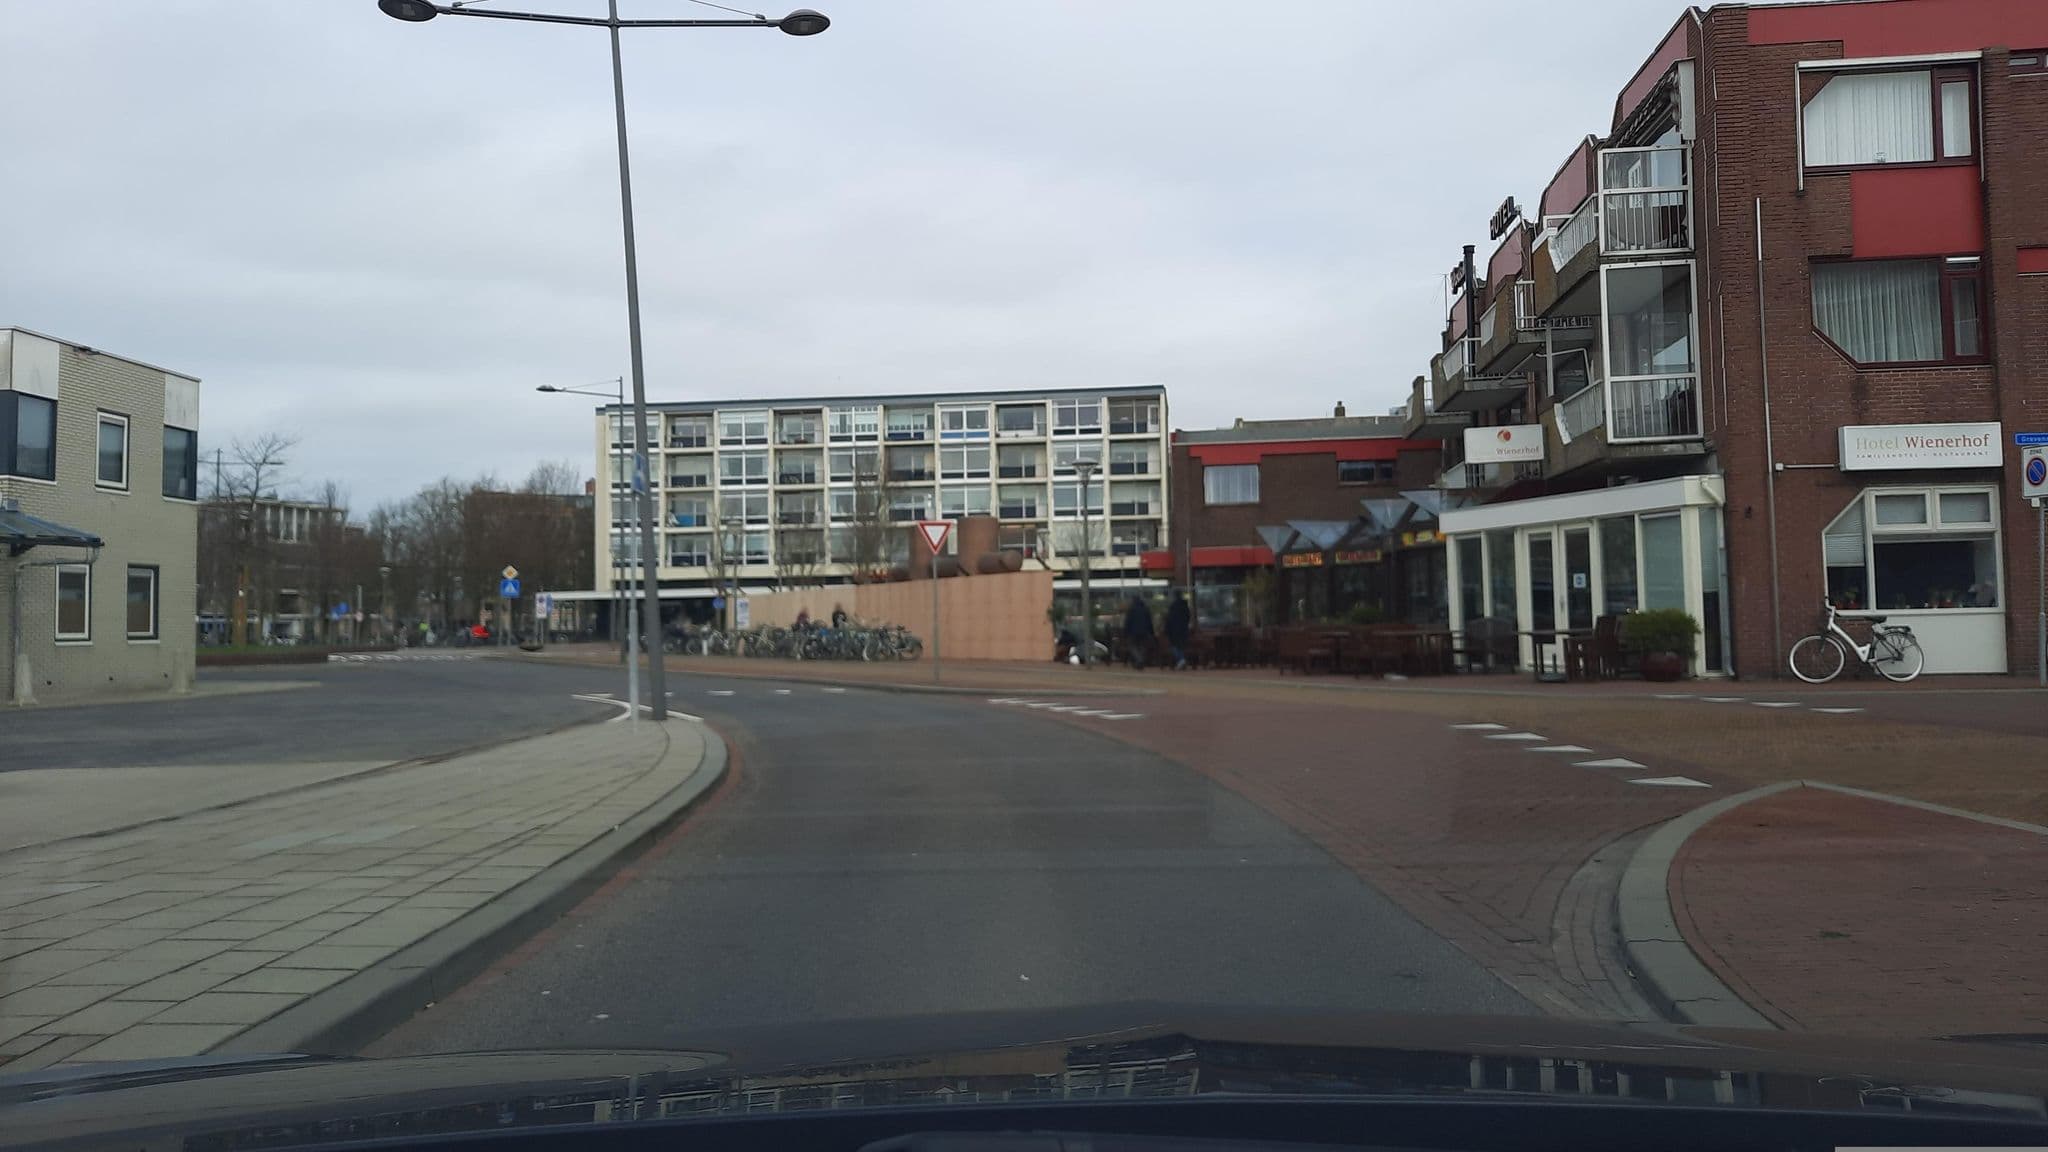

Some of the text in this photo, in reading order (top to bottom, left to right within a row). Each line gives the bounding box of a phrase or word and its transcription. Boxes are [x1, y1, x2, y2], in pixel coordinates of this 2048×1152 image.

[1490, 196, 1515, 240] HOTEL
[1857, 434, 1990, 450] Hotel Wienerhof
